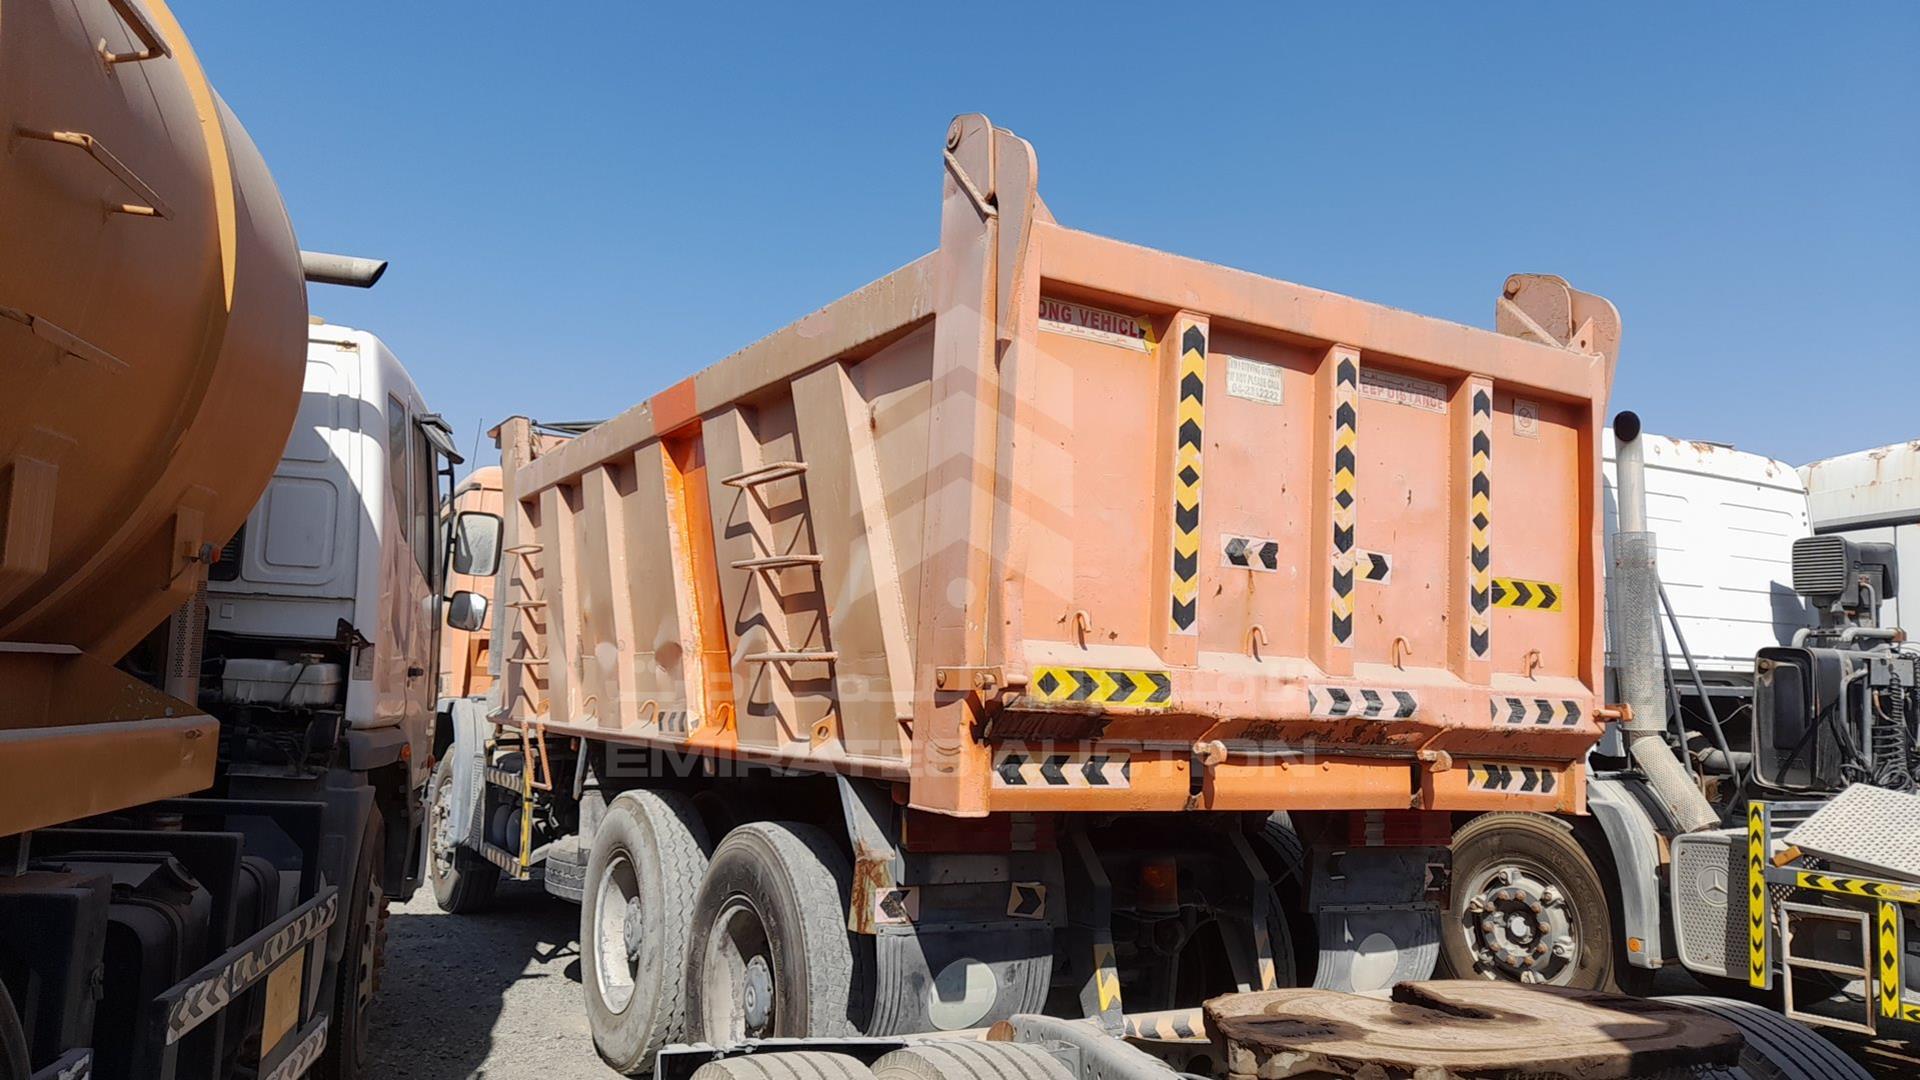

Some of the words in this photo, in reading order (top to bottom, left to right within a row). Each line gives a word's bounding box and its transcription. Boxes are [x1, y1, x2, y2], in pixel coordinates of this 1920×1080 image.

[1039, 300, 1072, 324] ONG
[1079, 308, 1139, 339] VEHICL
[1359, 384, 1384, 397] EEP
[1387, 388, 1443, 409] DISTANCE
